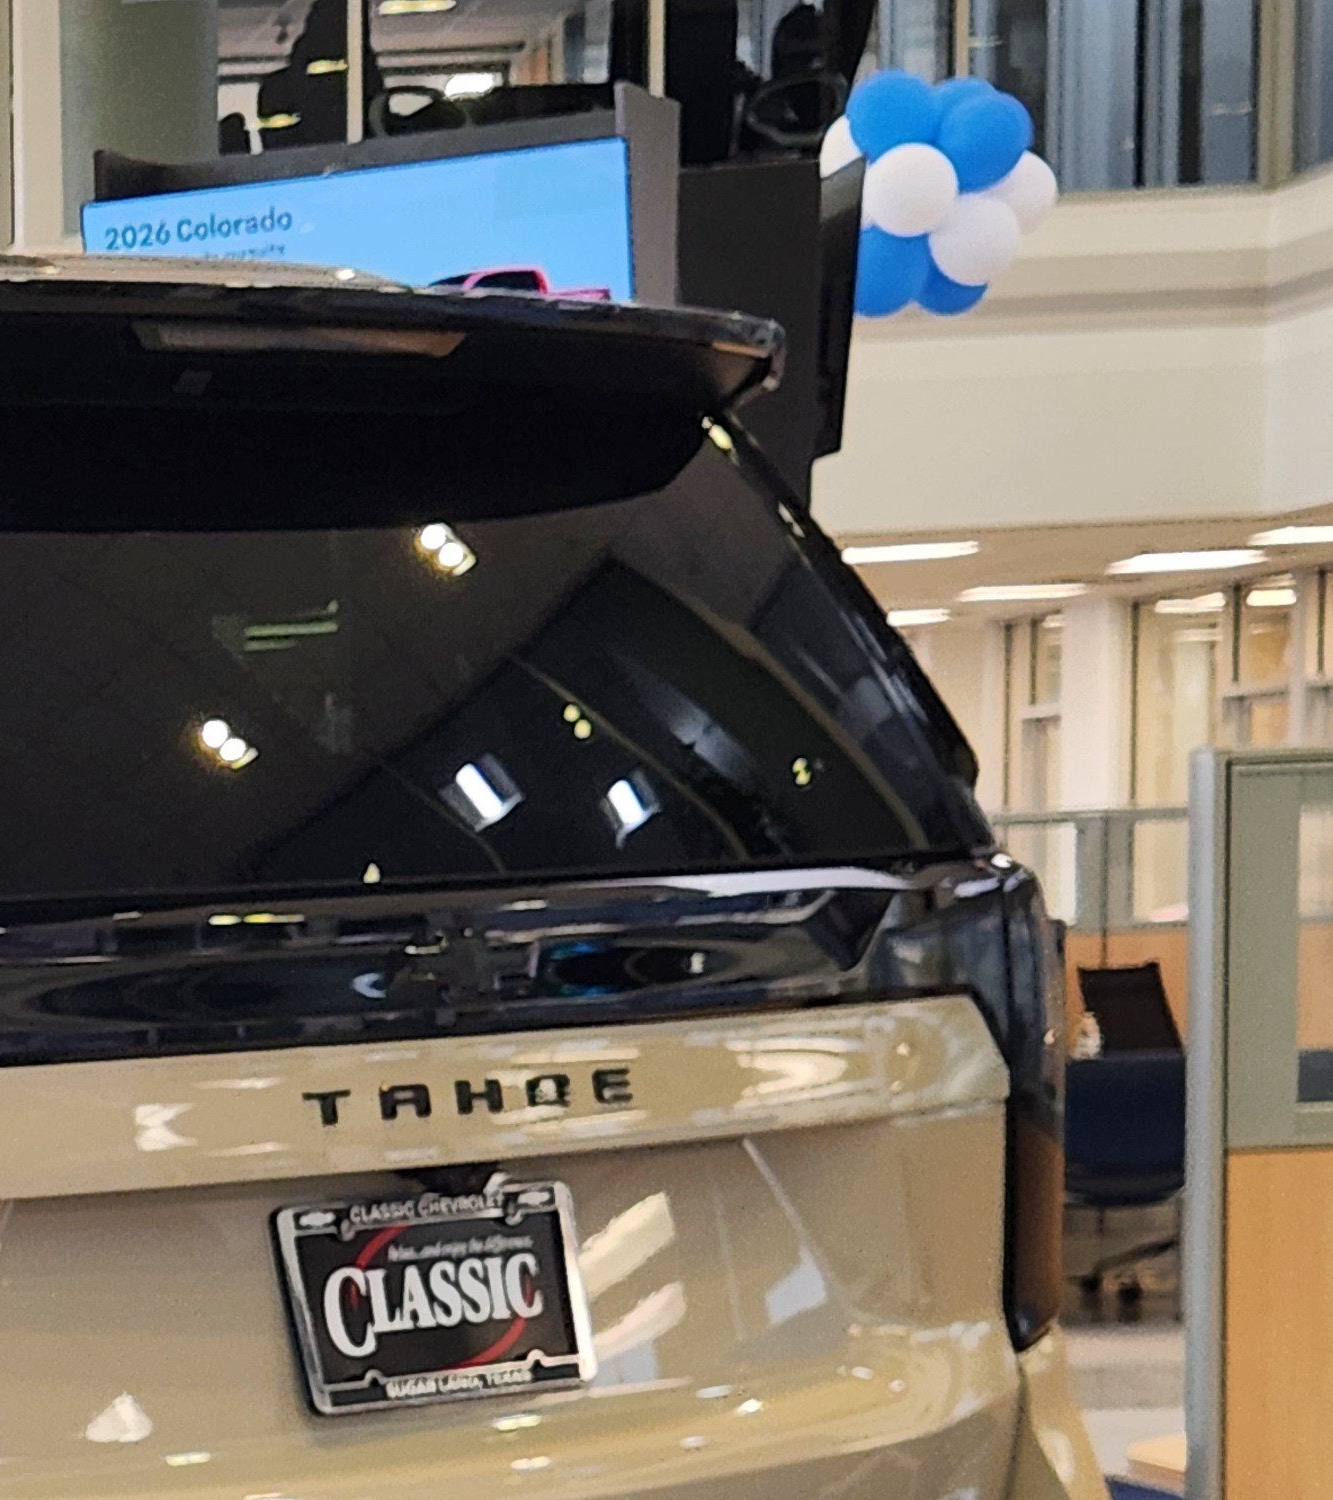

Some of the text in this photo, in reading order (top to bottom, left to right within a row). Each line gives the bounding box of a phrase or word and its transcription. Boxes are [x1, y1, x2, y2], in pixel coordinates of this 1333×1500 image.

[105, 206, 293, 250] 2026 Colorado
[302, 1067, 634, 1127] TAHOE
[324, 1253, 544, 1358] CLASSIC
